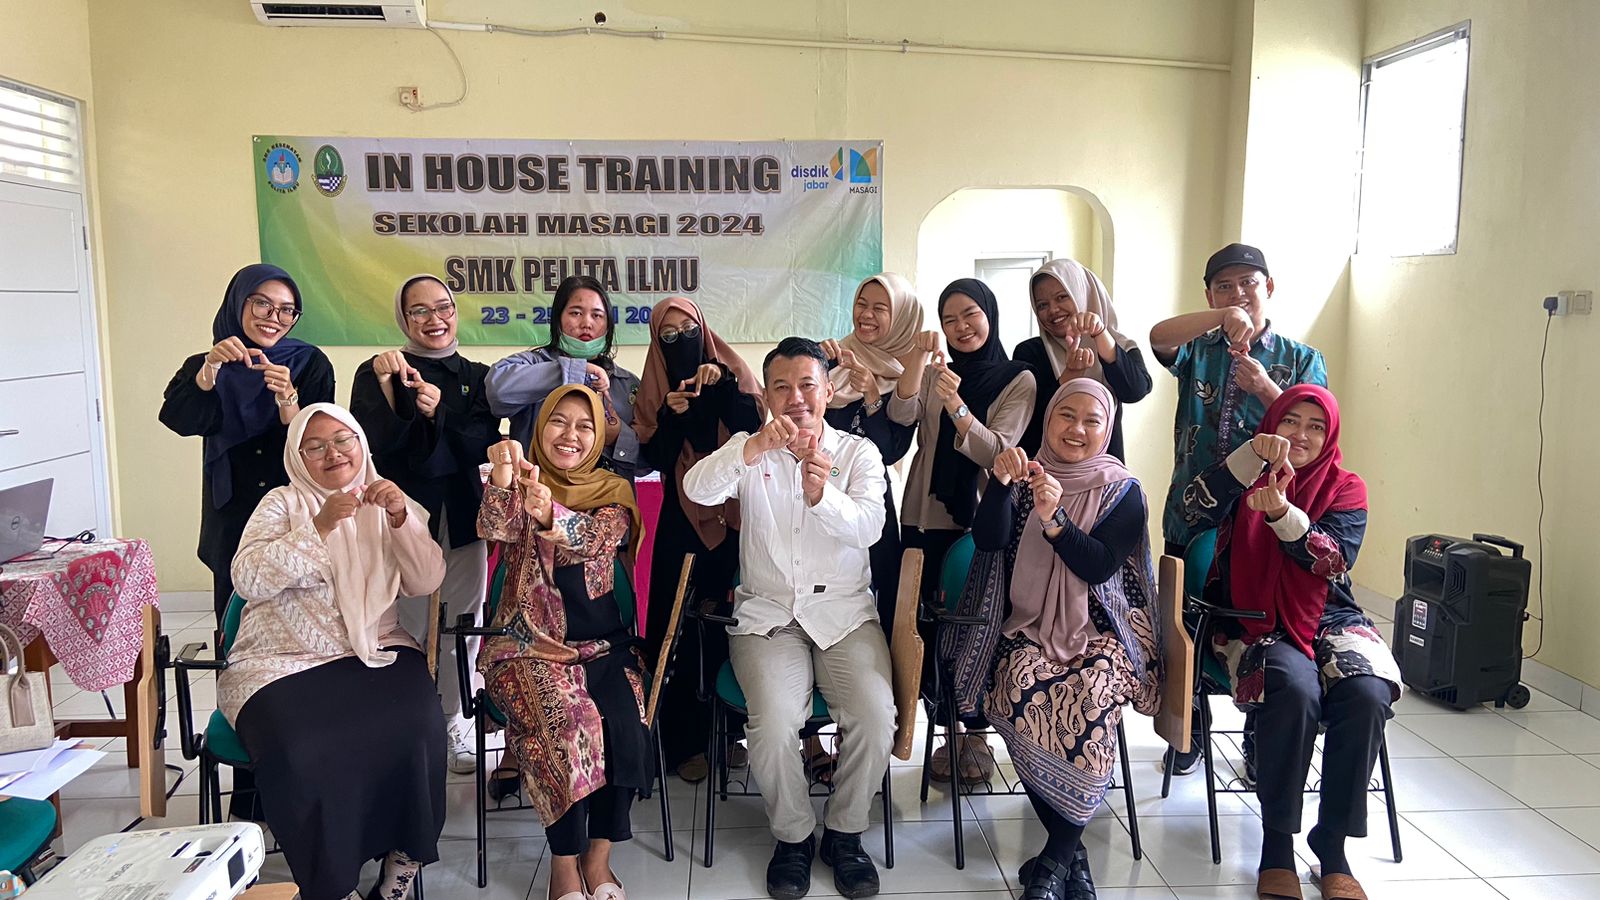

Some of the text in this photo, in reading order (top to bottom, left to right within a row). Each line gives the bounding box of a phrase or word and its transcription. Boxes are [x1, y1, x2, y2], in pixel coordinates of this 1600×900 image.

[365, 152, 412, 191] IN
[423, 154, 570, 193] HOUSE
[577, 155, 781, 193] TRAINING
[791, 165, 829, 178] disdik
[803, 180, 829, 192] jabar
[373, 212, 764, 236] SEKOLAH MASAGI 2024
[445, 257, 517, 294] SMK
[625, 257, 699, 294] ILMU
[481, 306, 510, 324] 23
